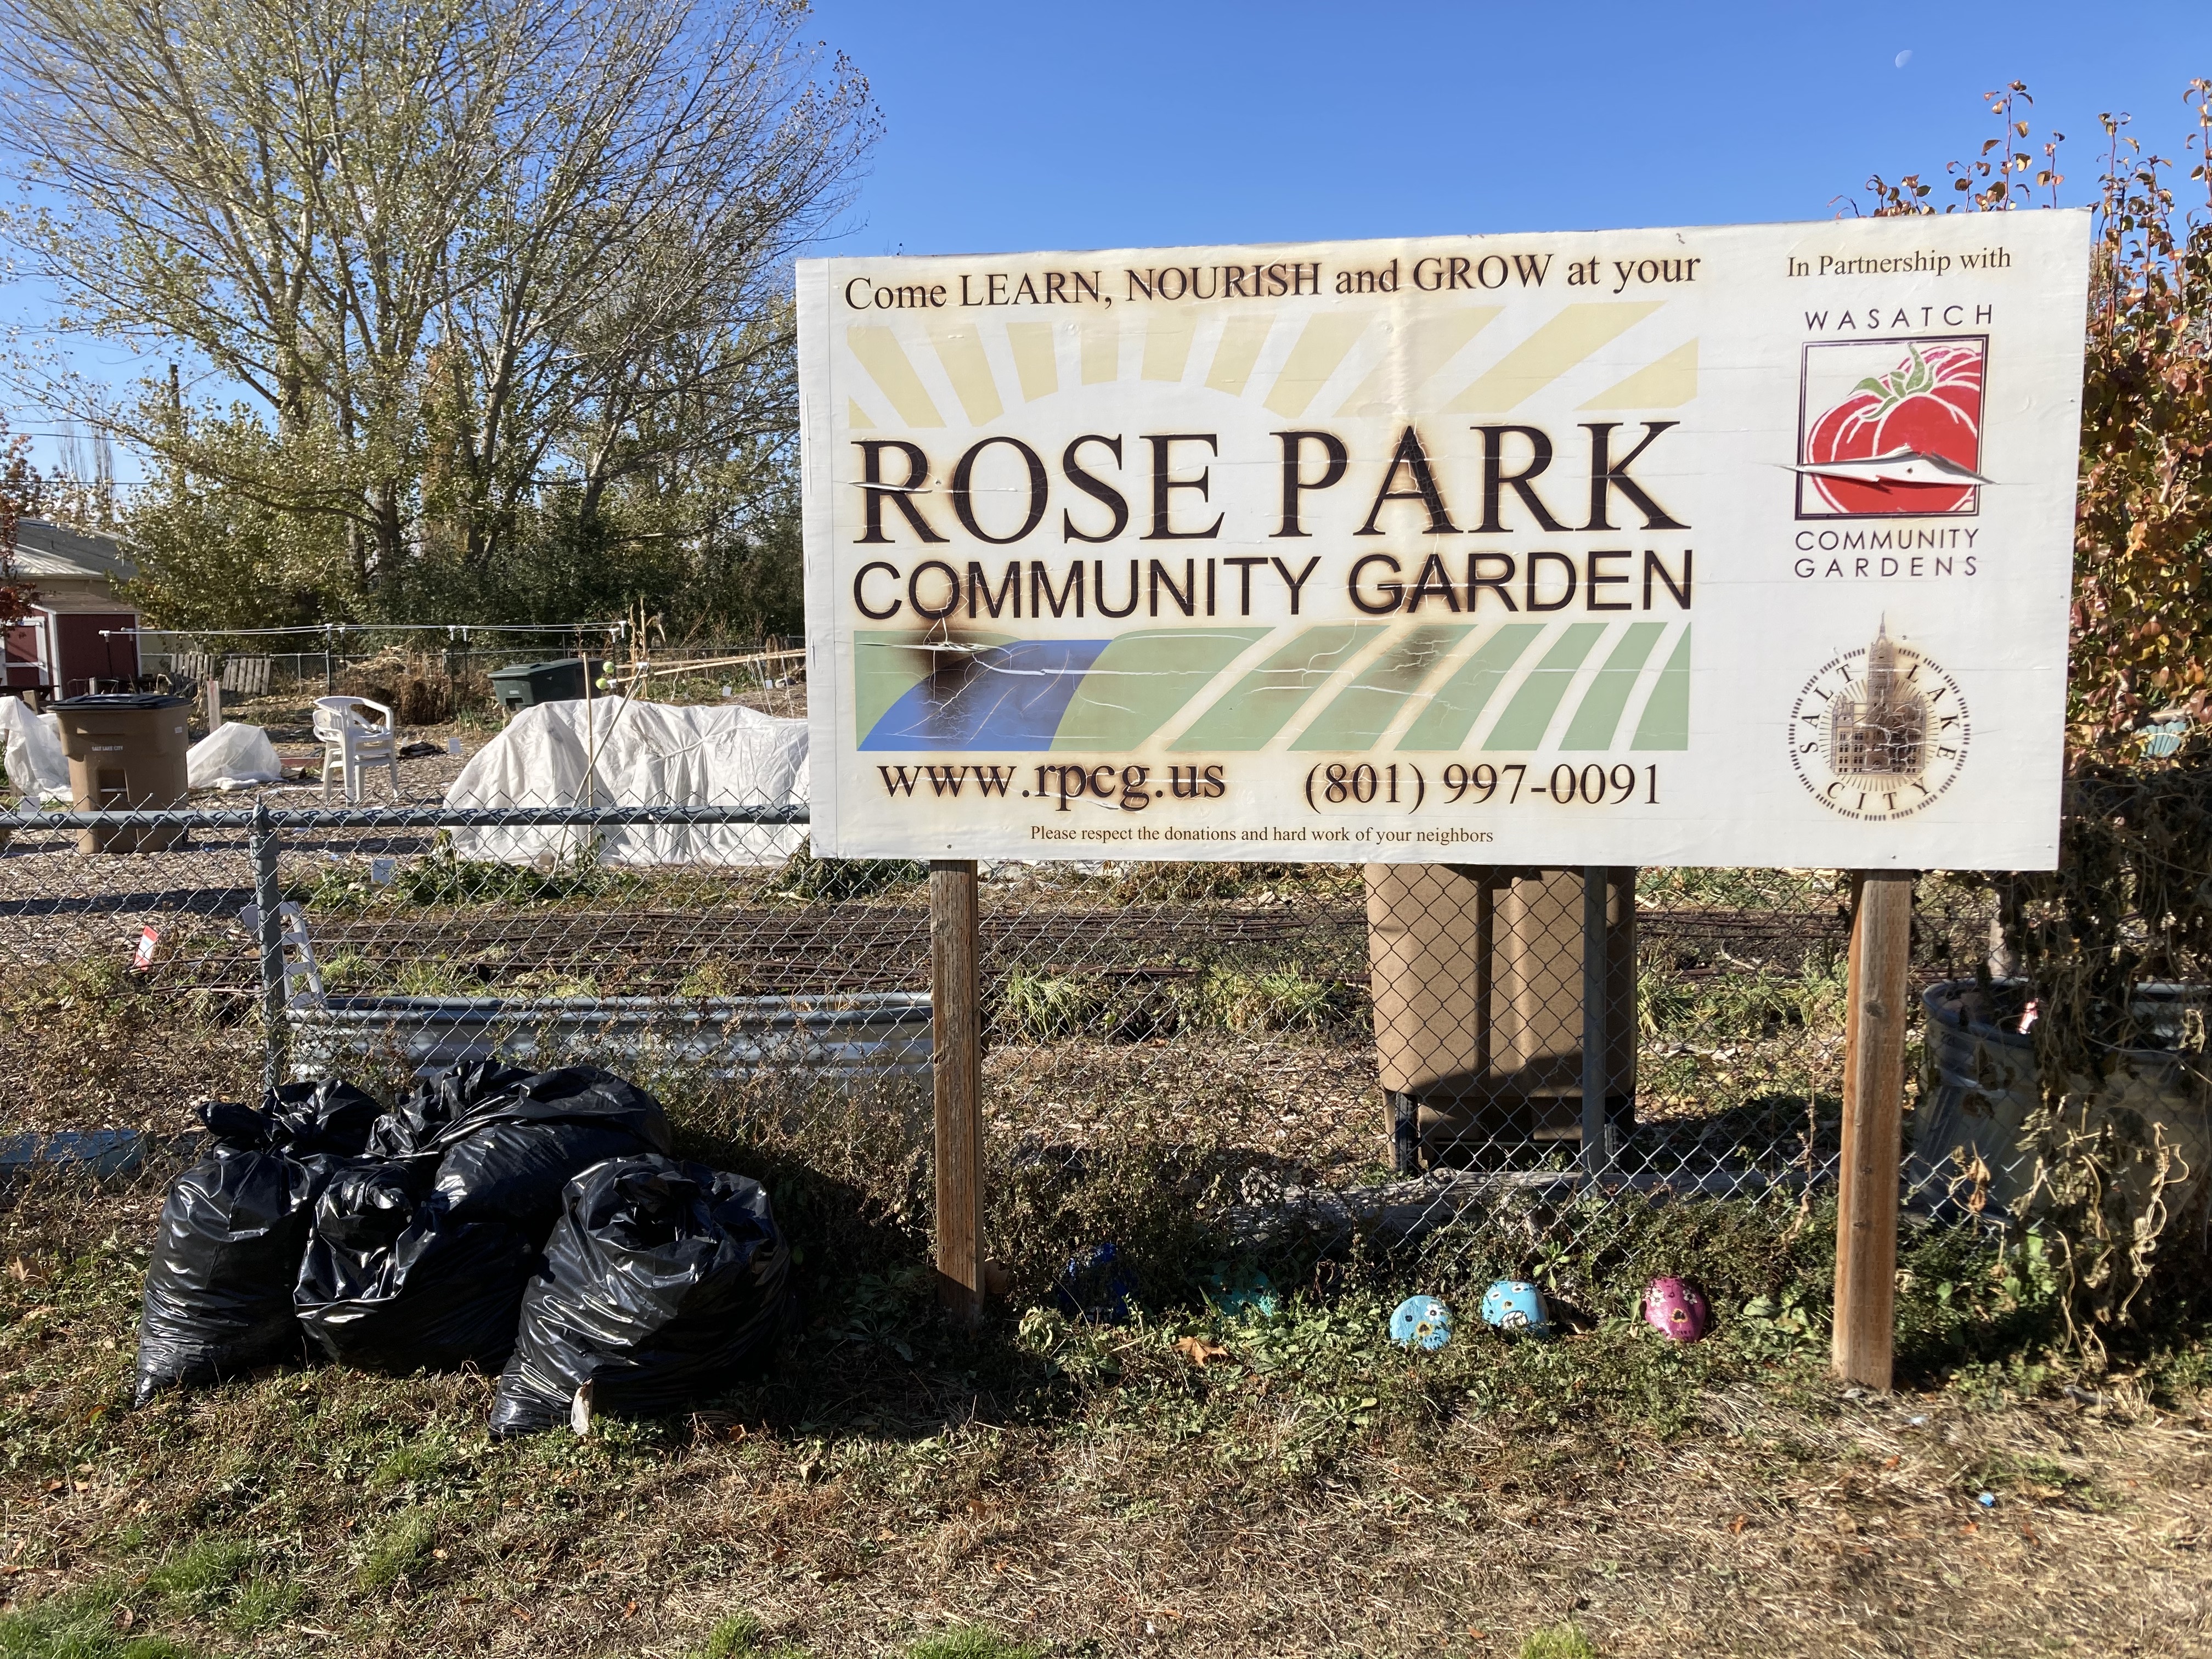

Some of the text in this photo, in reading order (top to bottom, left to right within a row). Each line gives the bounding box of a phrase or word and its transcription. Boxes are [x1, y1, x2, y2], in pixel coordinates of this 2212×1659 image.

[845, 254, 1701, 309] Come LEARN, NOURISH and GROW at your
[1788, 246, 2011, 277] In Partnership with
[1805, 304, 1992, 330] WASATCH
[850, 421, 1691, 544] ROSE PARK
[1795, 528, 1979, 551] COMMUNITY
[854, 549, 1692, 620] COMMUNITY GARDEN
[1795, 556, 1976, 578] GARDENS
[1799, 663, 1960, 760] SALT LAKE
[876, 765, 1225, 812] www.rpcg.us
[1305, 763, 1659, 815] (801) 997-0091
[1827, 777, 1930, 811] CITY
[1031, 826, 1493, 845] Please respect the donations and hard work of your neighbors
